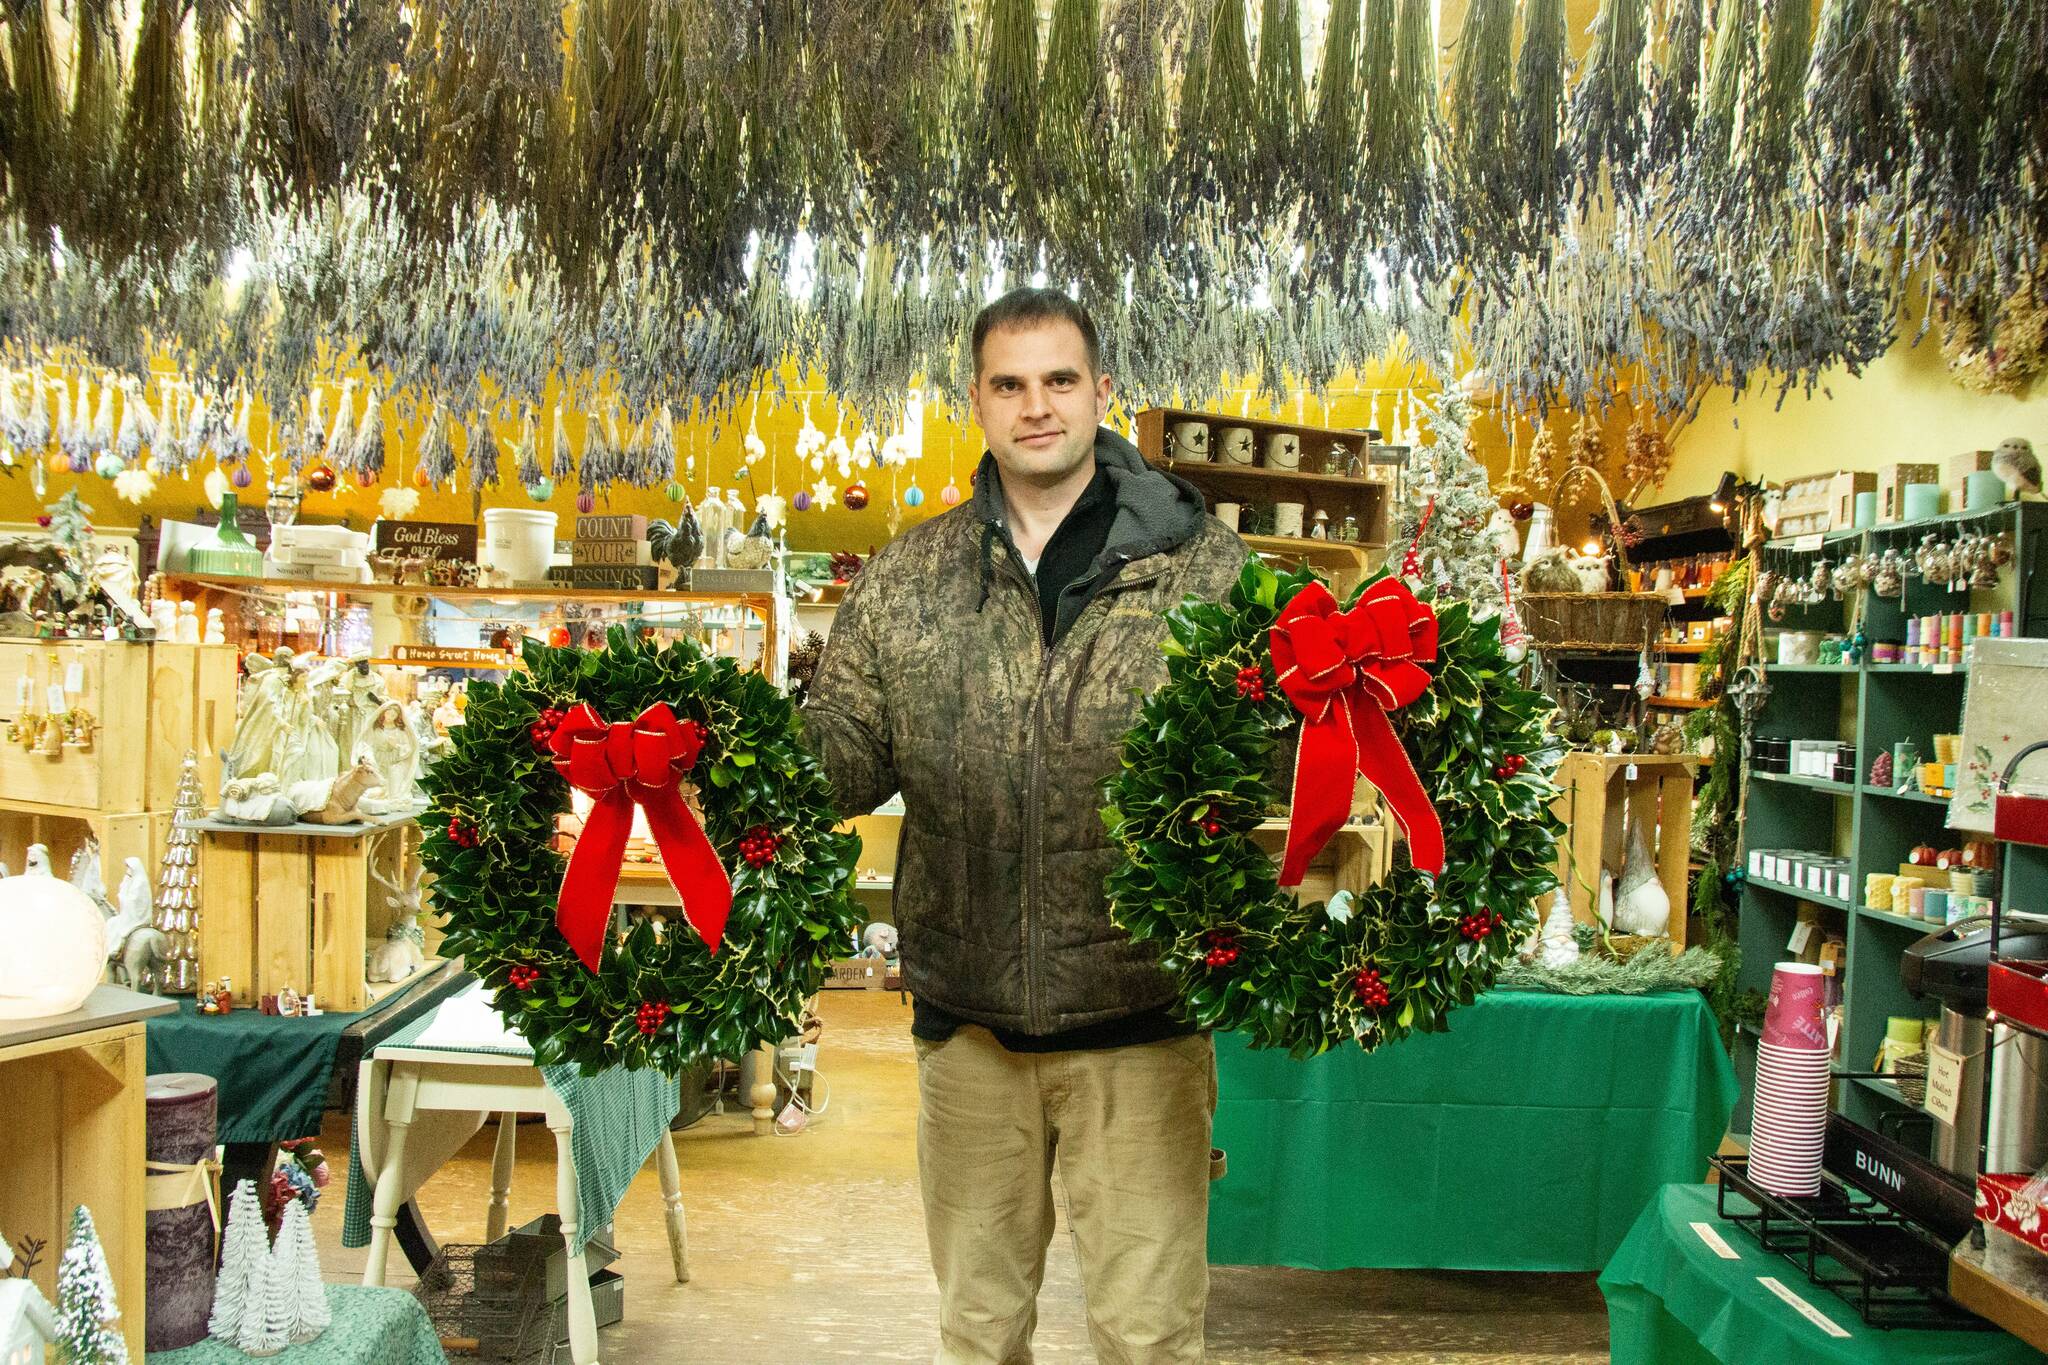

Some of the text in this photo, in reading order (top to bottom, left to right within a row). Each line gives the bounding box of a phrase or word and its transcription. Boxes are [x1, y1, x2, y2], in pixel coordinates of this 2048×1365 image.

[394, 526, 459, 545] God Bless
[577, 517, 632, 538] COUNT
[582, 543, 625, 562] YOUR
[409, 648, 500, 661] Home Sweet Home
[832, 967, 866, 981] ARDEN
